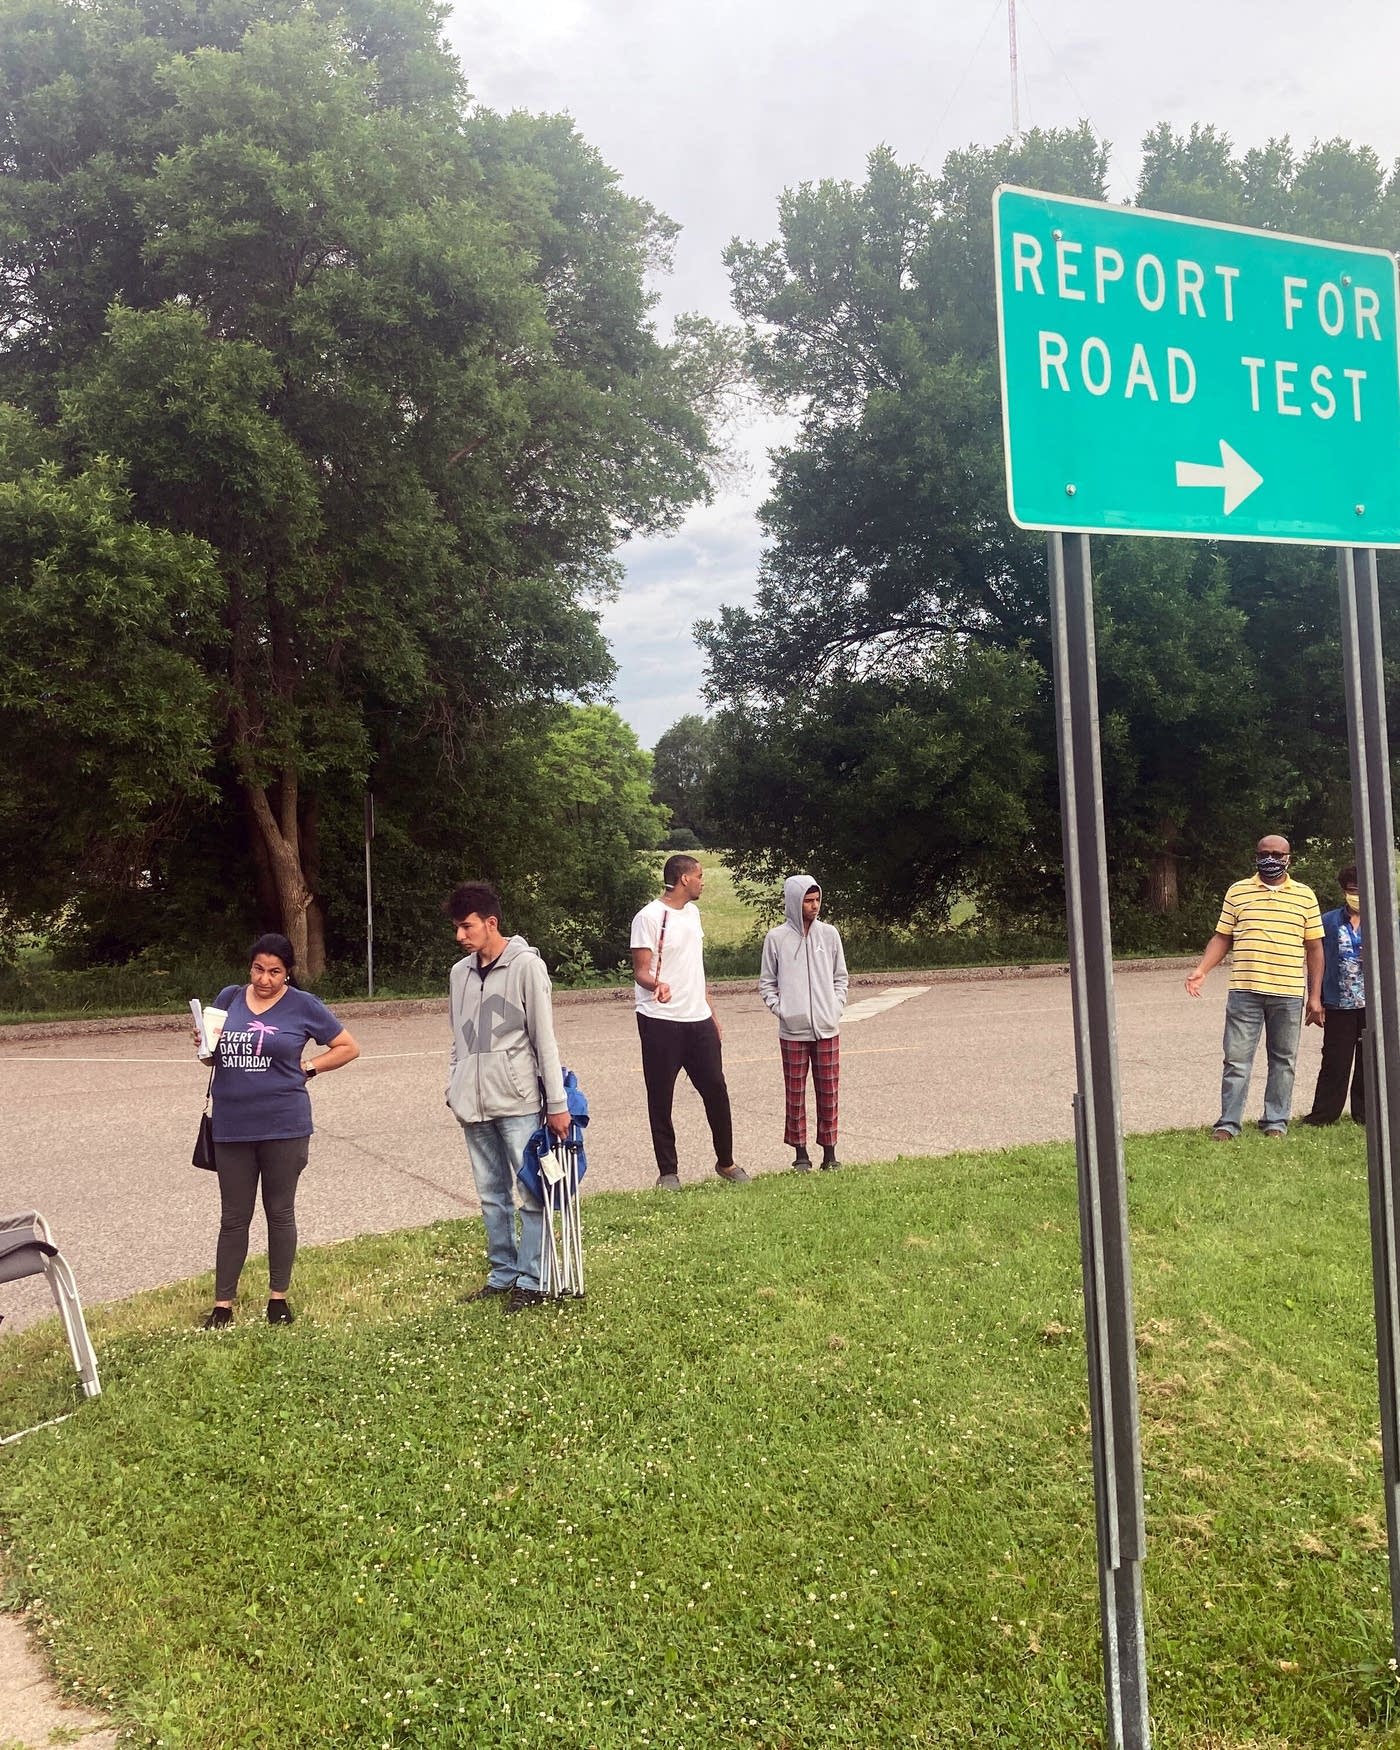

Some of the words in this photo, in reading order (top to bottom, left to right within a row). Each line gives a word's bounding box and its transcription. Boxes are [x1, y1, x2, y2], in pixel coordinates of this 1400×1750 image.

[1013, 233, 1239, 321] REPORT
[1284, 276, 1382, 341] FOR
[1039, 331, 1197, 404] ROAD
[1242, 357, 1366, 422] TEST
[220, 1031, 254, 1042] EVERY
[220, 1043, 239, 1055] DAY
[242, 1043, 252, 1055] IS
[222, 1056, 272, 1068] SATURDAY
